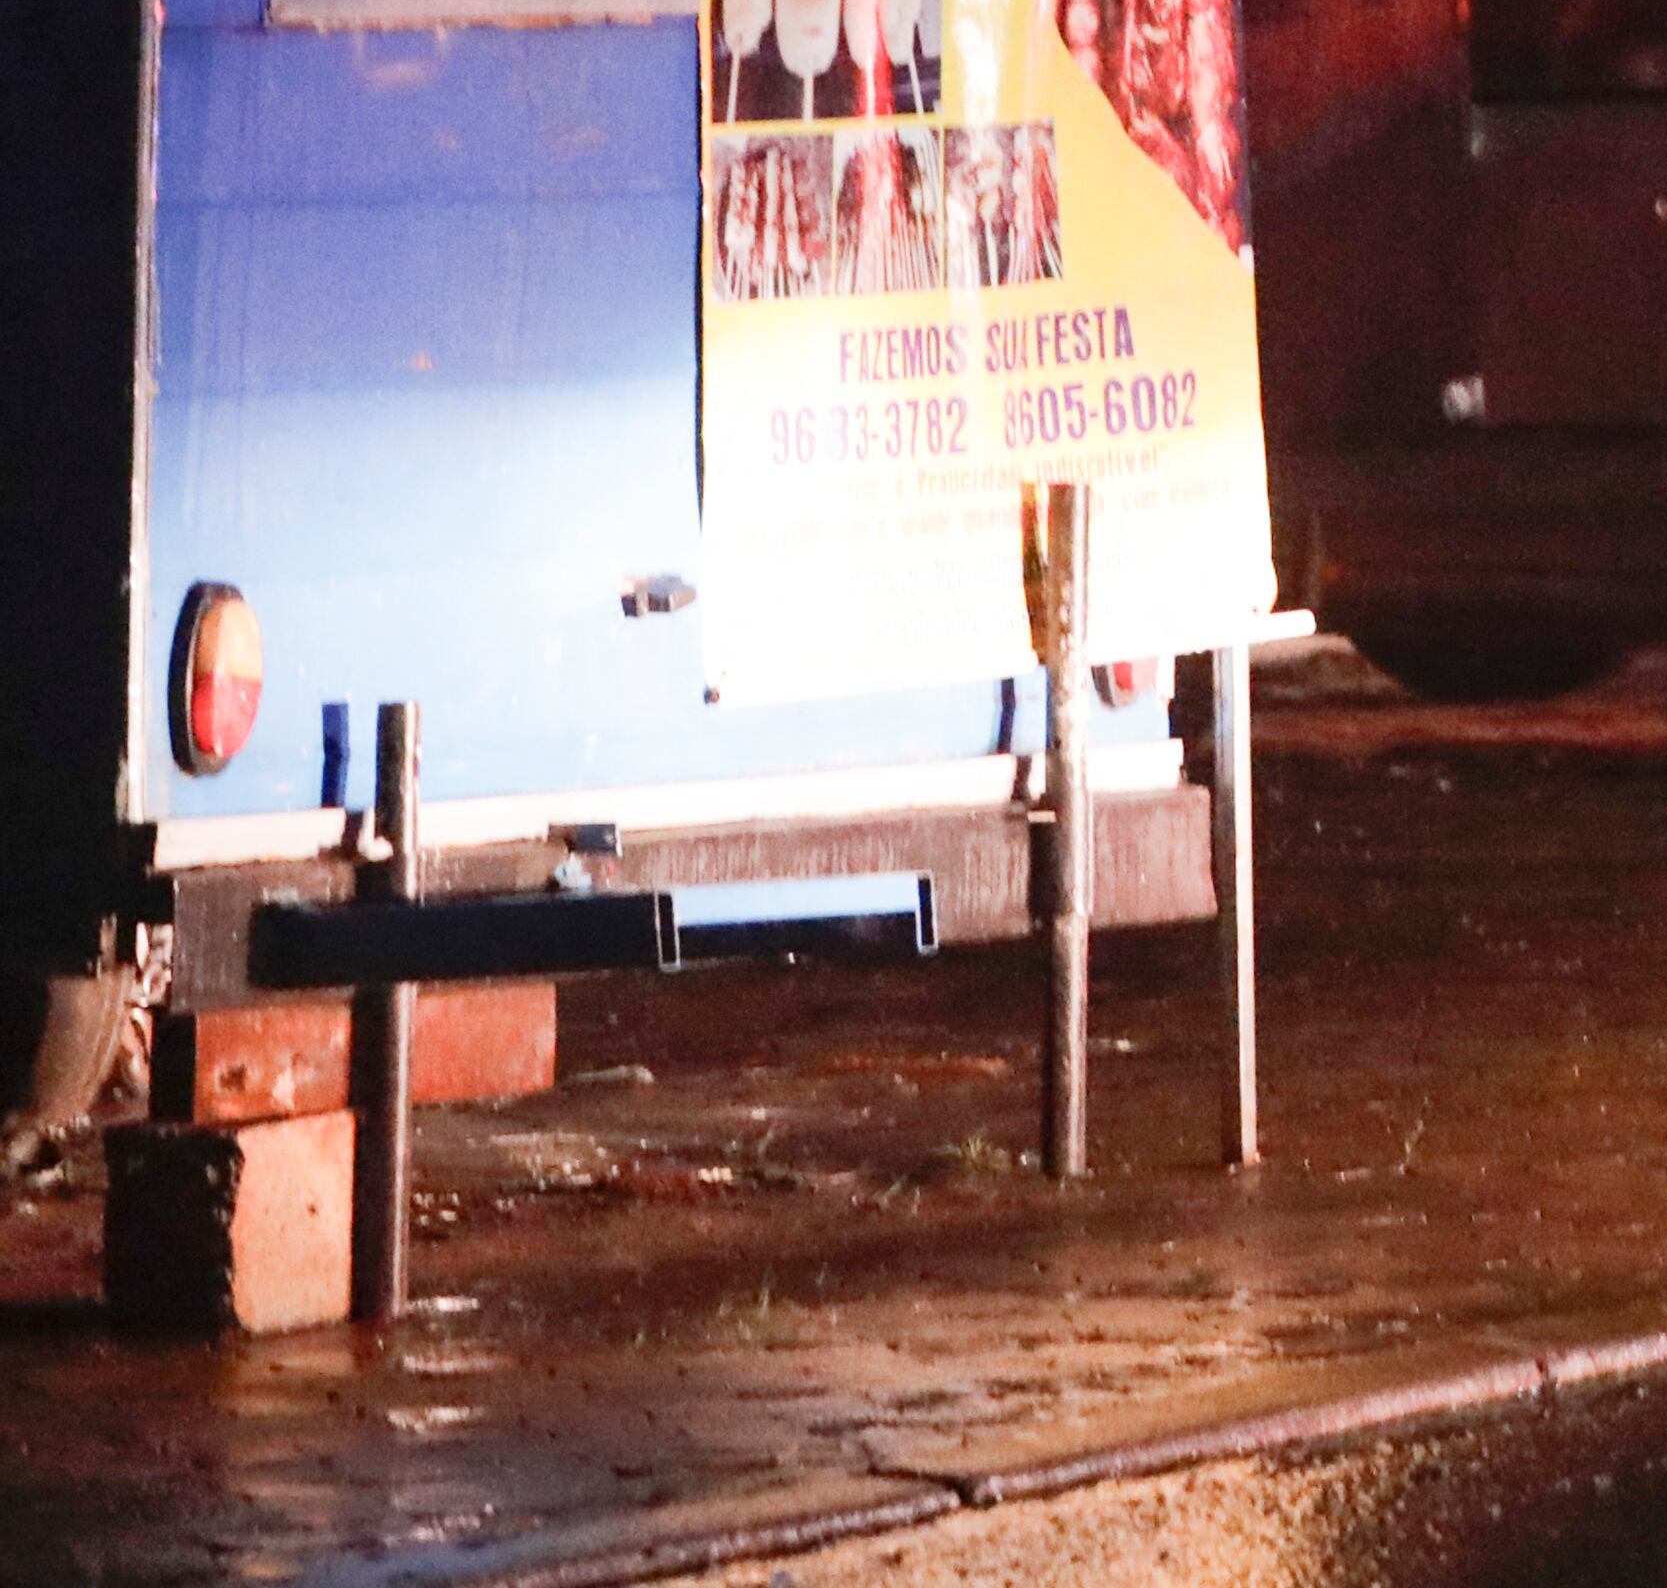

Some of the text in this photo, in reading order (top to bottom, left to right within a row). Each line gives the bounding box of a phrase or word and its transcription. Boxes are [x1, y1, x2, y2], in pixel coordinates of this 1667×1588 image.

[839, 321, 969, 384] FAZEMOS
[1034, 304, 1137, 368] FESTA
[1003, 370, 1198, 451] 8605-6082
